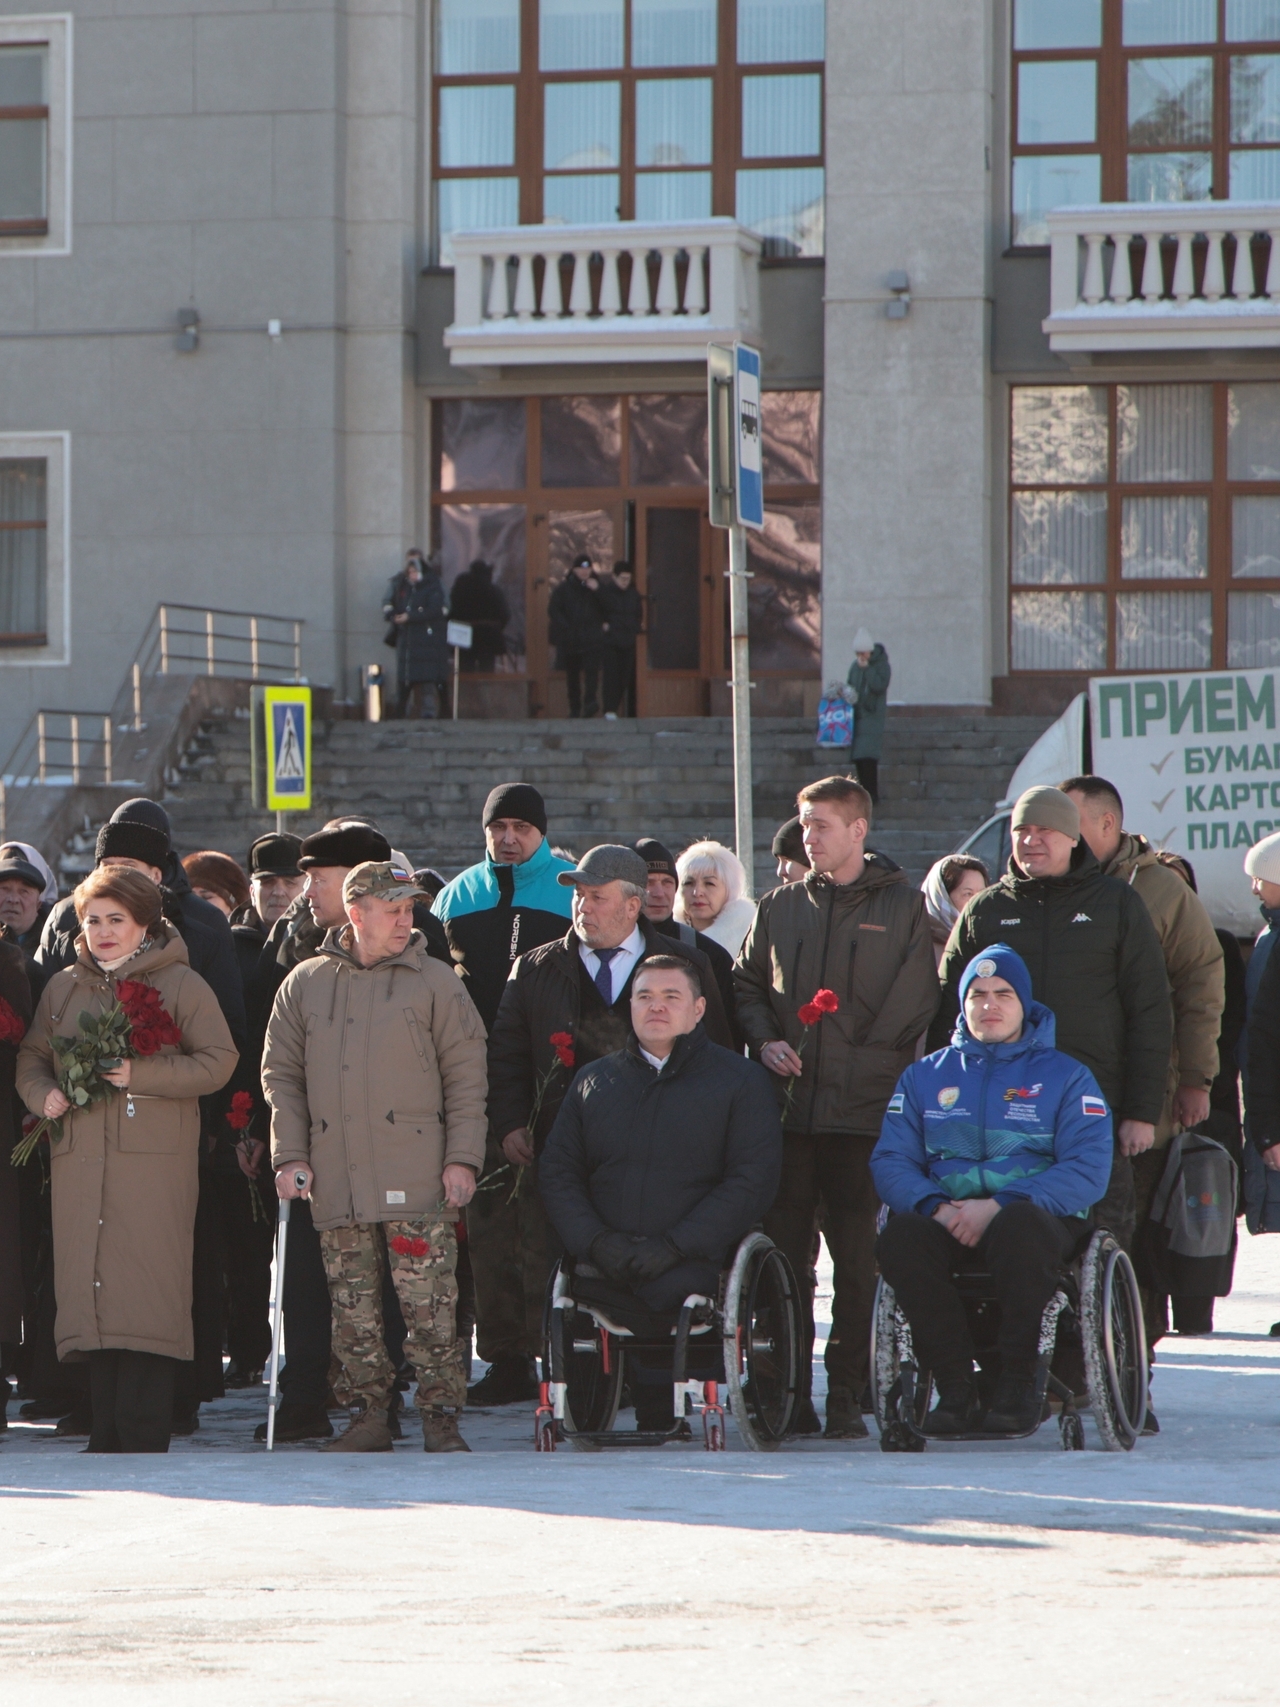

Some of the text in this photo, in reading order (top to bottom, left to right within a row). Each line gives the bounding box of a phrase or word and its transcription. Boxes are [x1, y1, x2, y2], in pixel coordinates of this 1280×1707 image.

[1098, 674, 1277, 739] ПРИЕМ
[1187, 819, 1280, 851] ПЛАС
[509, 913, 521, 960] NORDSKI
